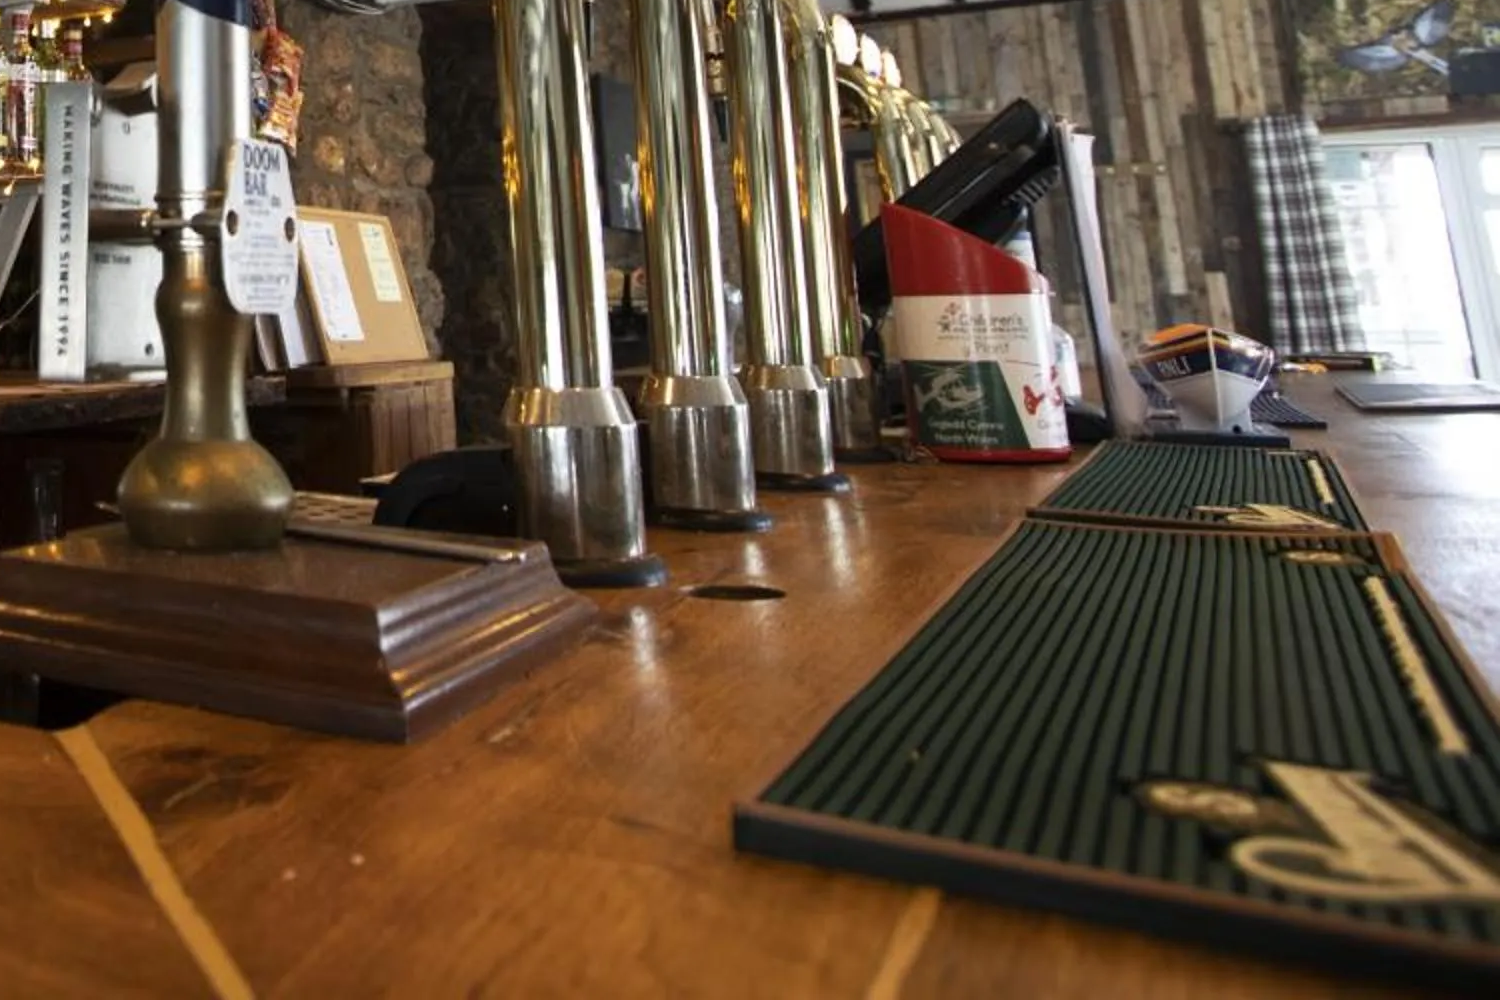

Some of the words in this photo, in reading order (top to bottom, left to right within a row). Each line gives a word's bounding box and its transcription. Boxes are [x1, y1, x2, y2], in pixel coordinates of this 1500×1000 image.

[62, 104, 74, 175] MAKING
[243, 143, 281, 172] DOOM
[59, 182, 72, 244] WAVES
[57, 253, 71, 307] SINCE
